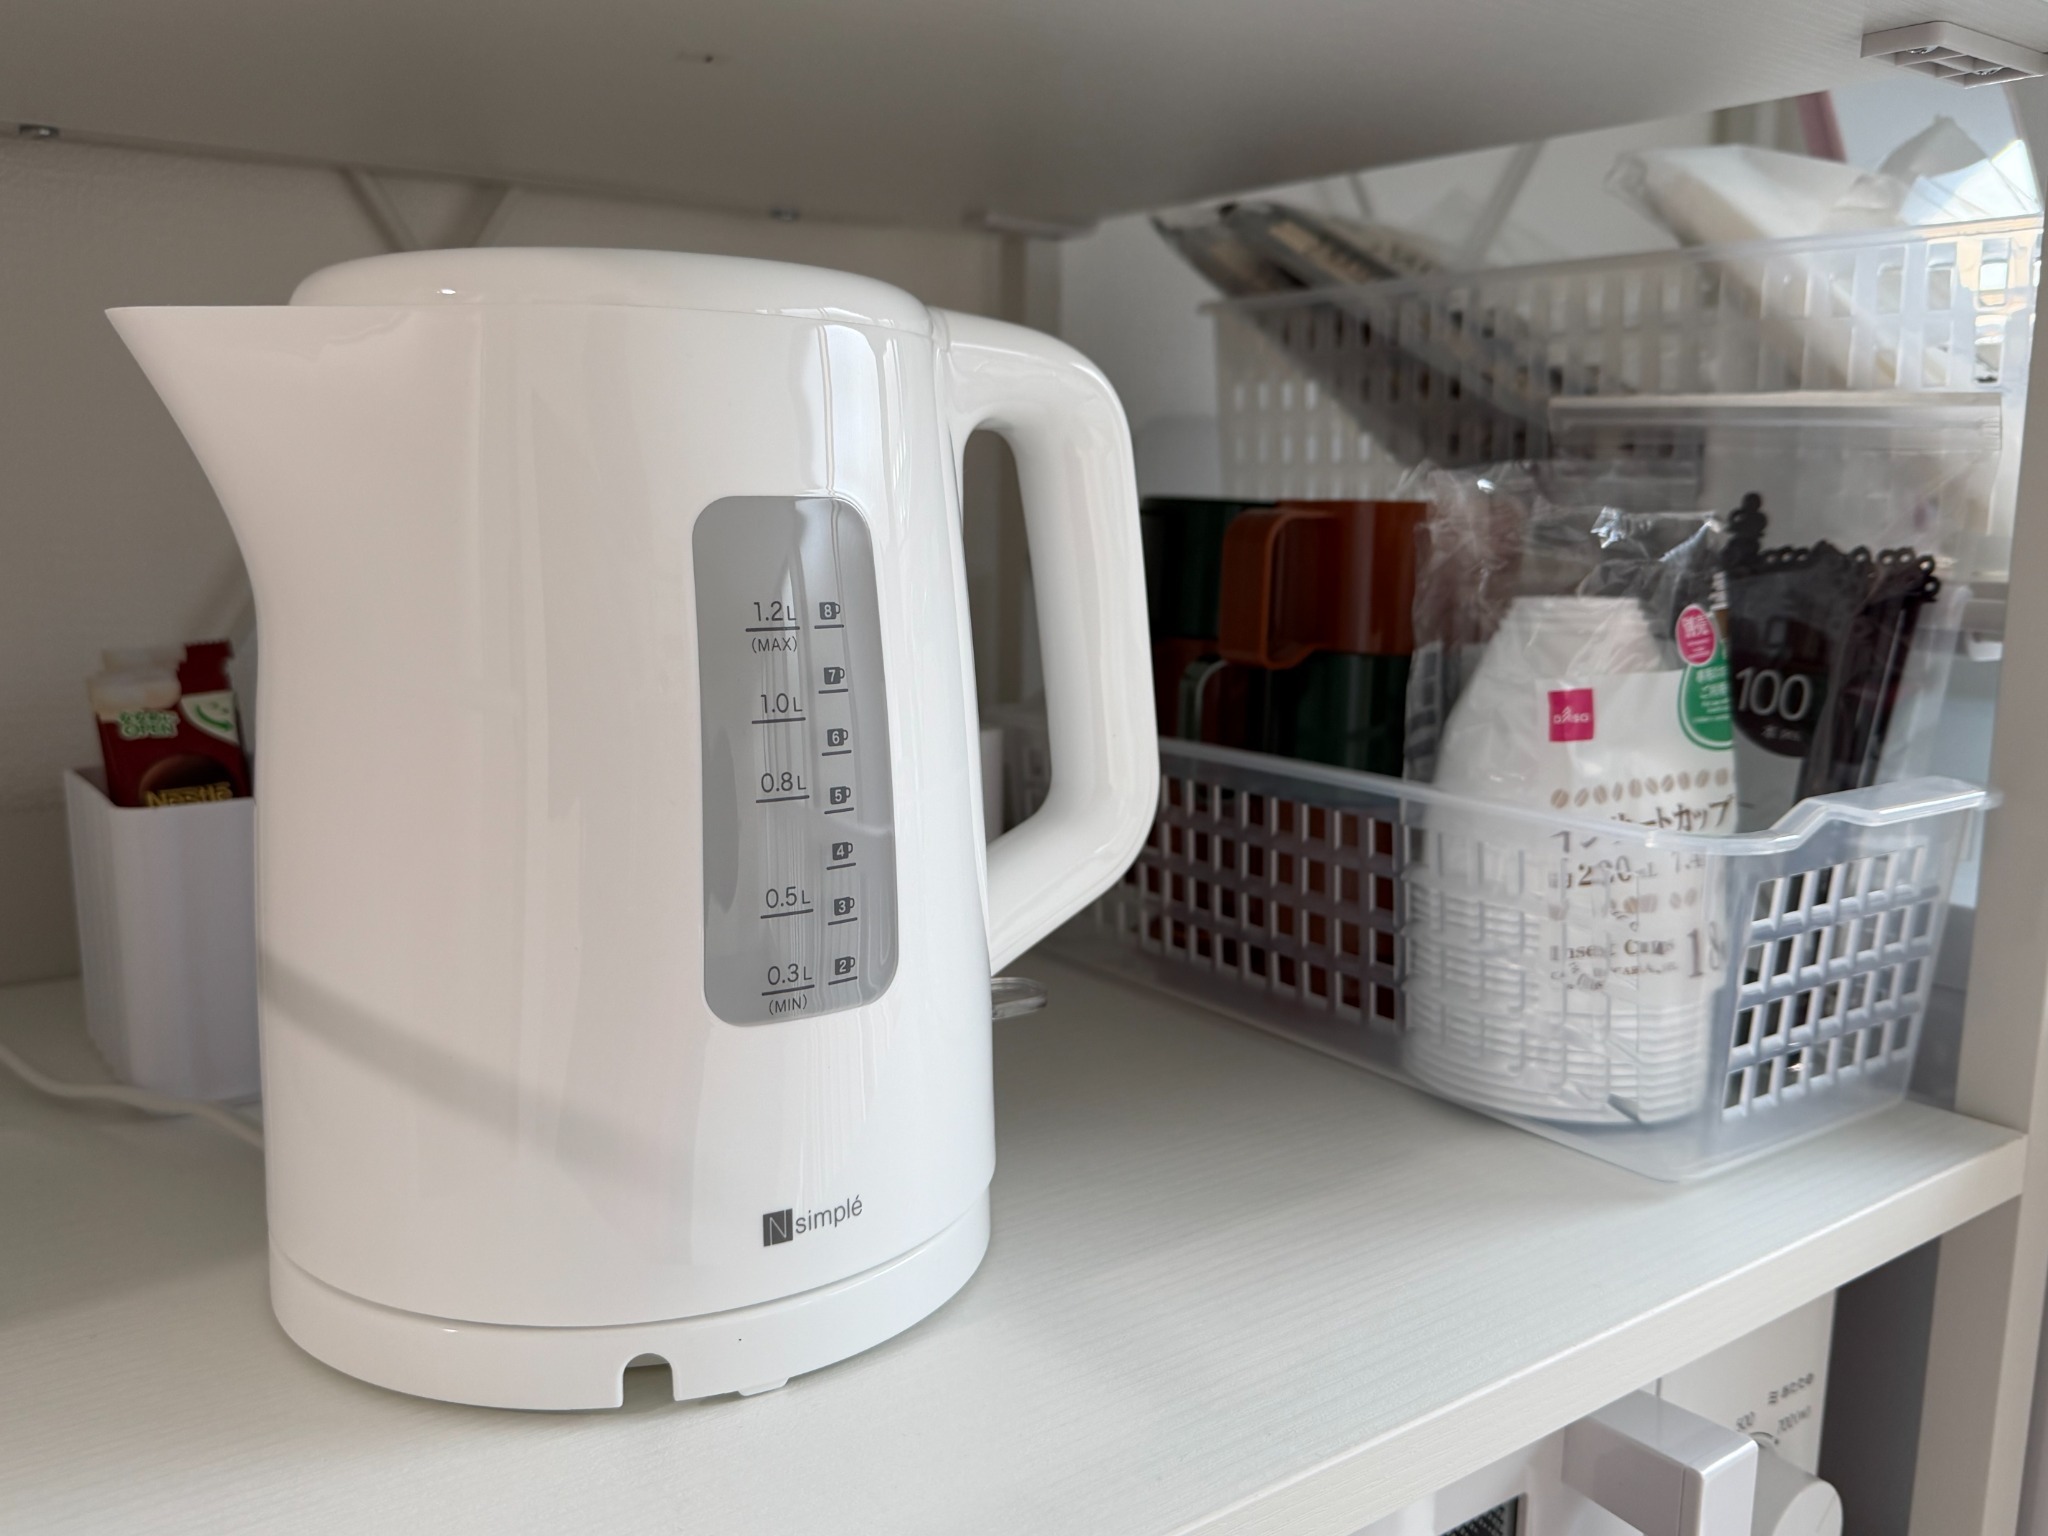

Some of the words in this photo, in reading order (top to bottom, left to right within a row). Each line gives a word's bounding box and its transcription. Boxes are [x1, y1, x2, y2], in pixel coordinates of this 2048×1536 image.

[753, 600, 797, 622] 1.2L
[752, 636, 798, 654] (MAX)
[760, 693, 803, 714] 1.0L
[1735, 667, 1813, 722] 100
[761, 772, 807, 793] 0.8L
[765, 886, 811, 908] 0.5L
[767, 963, 812, 986] 0.3L
[769, 994, 807, 1015] (MIN)
[795, 1194, 862, 1234] simplé
